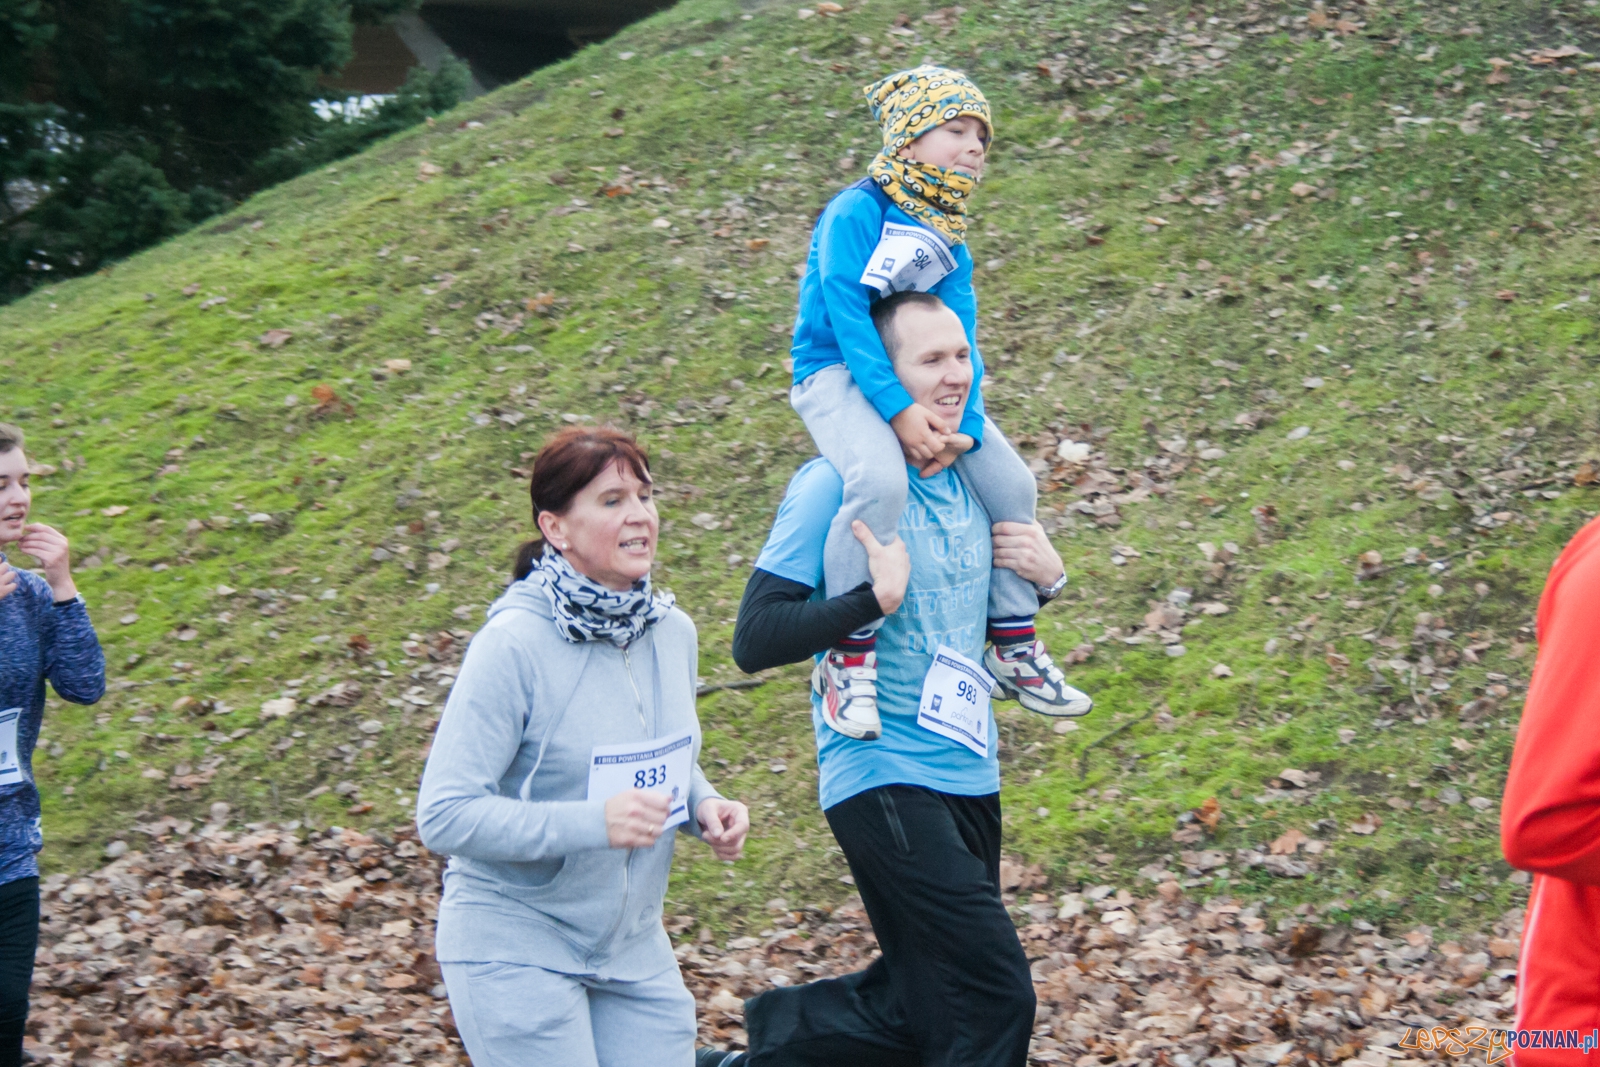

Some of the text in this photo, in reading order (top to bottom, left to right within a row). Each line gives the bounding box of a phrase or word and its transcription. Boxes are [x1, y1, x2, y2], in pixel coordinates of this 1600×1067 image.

[911, 248, 933, 272] 984
[956, 680, 977, 705] 983
[602, 756, 617, 764] BIEG
[618, 751, 654, 763] POWSTANIA
[634, 764, 667, 789] 833
